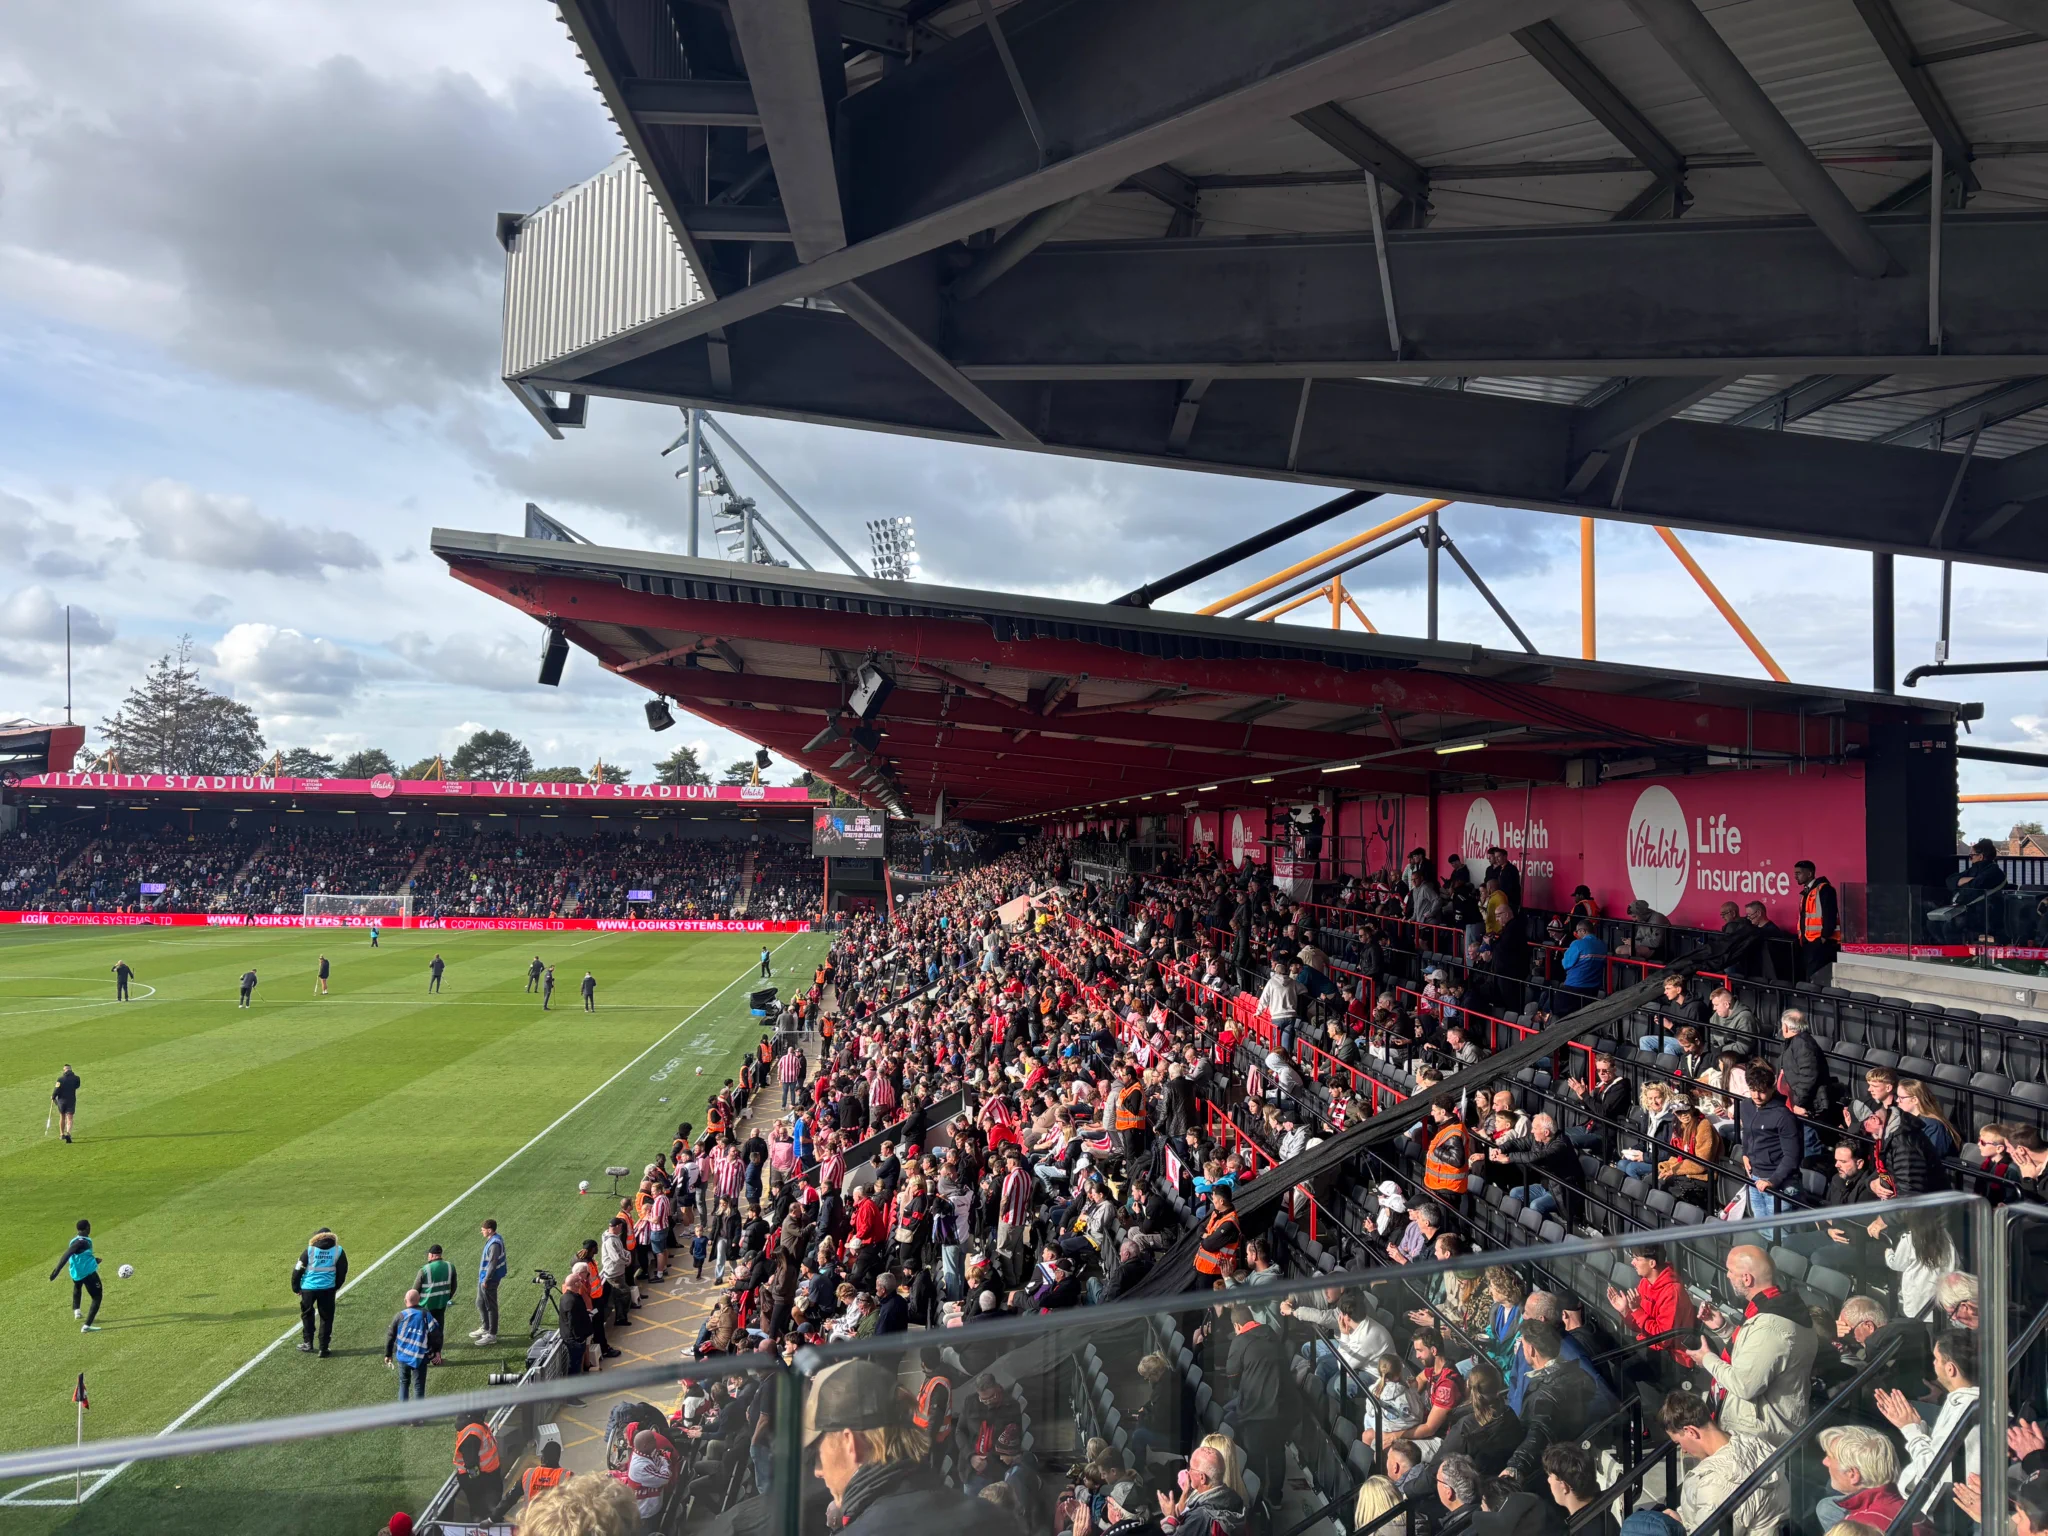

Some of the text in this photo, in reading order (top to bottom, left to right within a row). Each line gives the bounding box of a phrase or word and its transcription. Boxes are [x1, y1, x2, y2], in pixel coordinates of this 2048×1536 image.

[39, 773, 275, 790] VITALITY STADIUM
[371, 780, 394, 791] Vitality
[492, 782, 717, 798] VITALITY STADIUM
[742, 787, 764, 798] Vitality
[1697, 814, 1741, 854] Life
[1629, 819, 1686, 885] Vitality
[1697, 860, 1790, 895] insurance
[53, 915, 100, 924] COPYING
[103, 916, 150, 925] SYSTEMS
[451, 920, 495, 930] COPYING
[498, 921, 544, 930] SYSTEMS
[546, 921, 564, 930] LTD
[596, 921, 765, 931] WWW.LOGIKSYSTEMS.CO.UK
